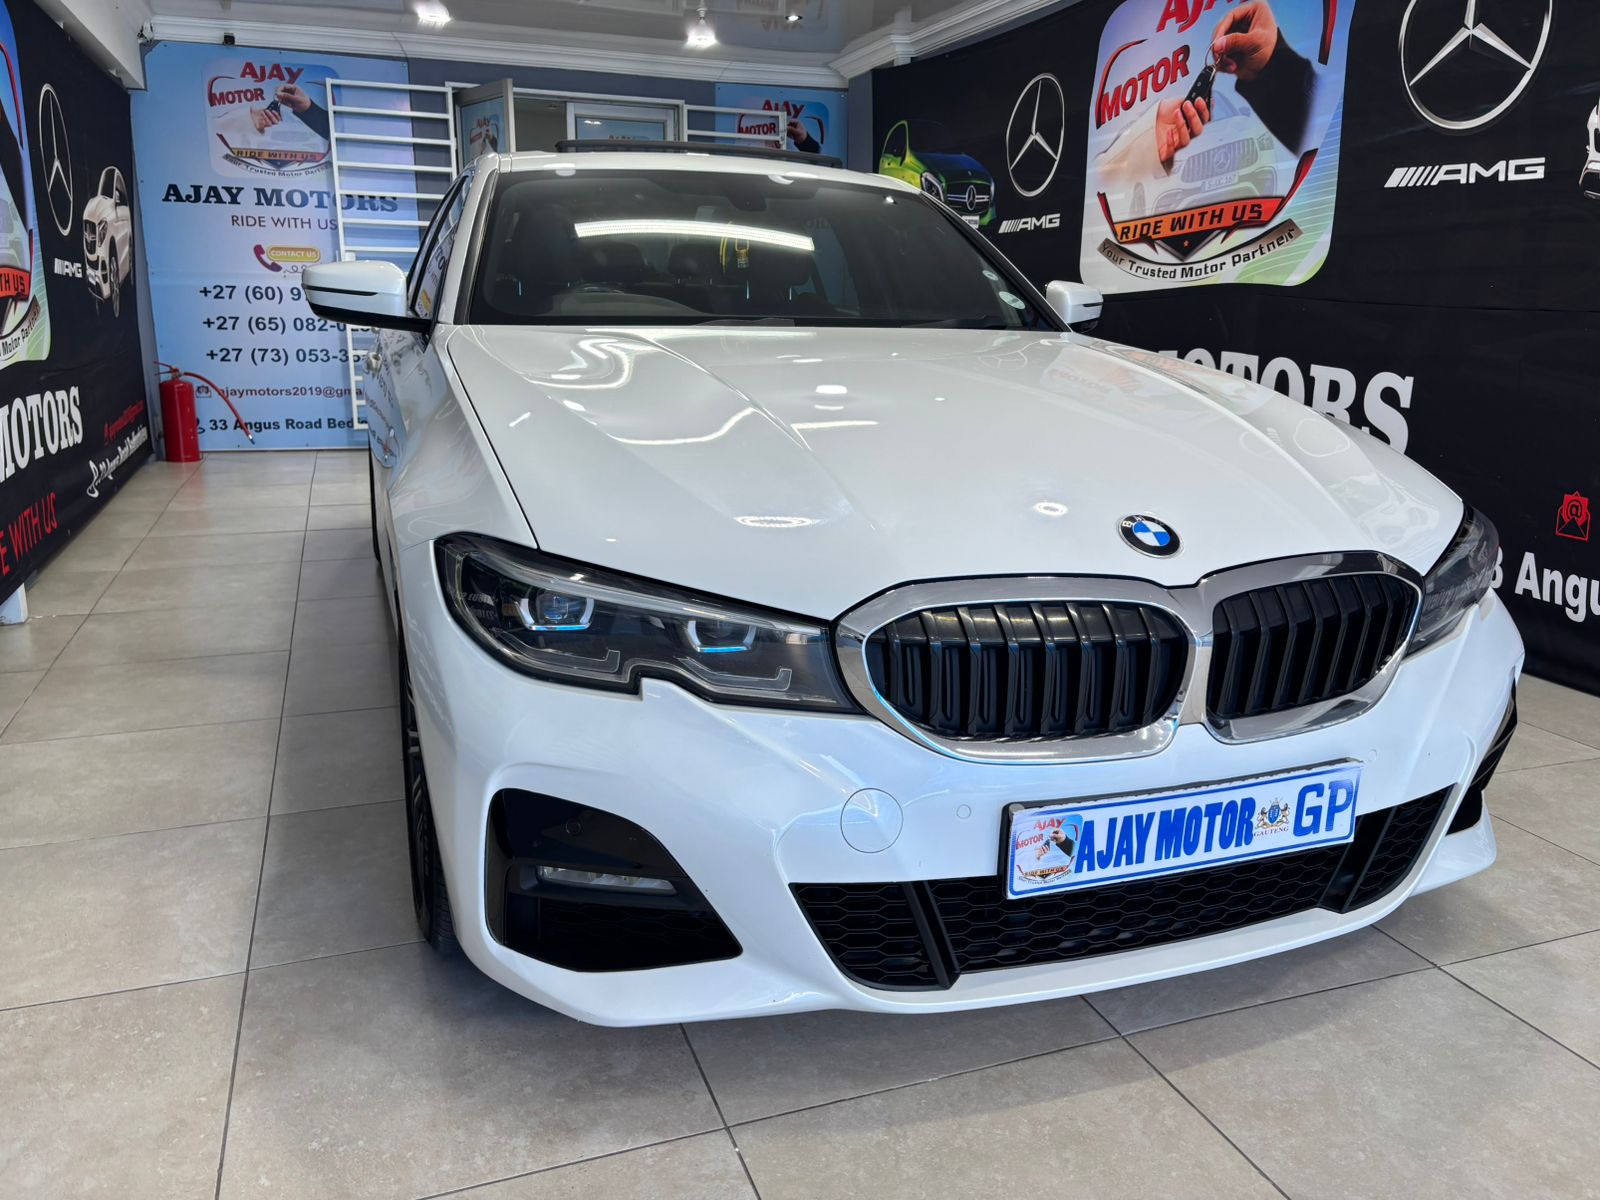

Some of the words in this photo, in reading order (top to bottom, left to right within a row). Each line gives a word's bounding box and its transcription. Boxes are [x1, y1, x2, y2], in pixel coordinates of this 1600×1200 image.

[240, 62, 304, 84] AJAY
[1099, 45, 1190, 126] MOTOR
[211, 88, 265, 106] MOTOR
[268, 151, 297, 159] WITH
[162, 184, 244, 205] AJAY
[254, 188, 398, 212] MOTORS
[231, 215, 266, 228] RIDE
[270, 216, 312, 230] WITH
[318, 219, 338, 231] US
[1119, 220, 1162, 241] RIDE
[1169, 208, 1222, 234] WITH
[1232, 202, 1263, 222] US
[271, 249, 305, 257] CONTACT
[1100, 242, 1125, 266] Your
[1128, 259, 1177, 279] Trusted
[1180, 260, 1227, 279] Motor
[1231, 227, 1297, 267] Partner
[13, 273, 26, 293] US
[199, 284, 237, 300] +27
[245, 285, 284, 304] (60)
[202, 316, 239, 330] +27
[248, 316, 286, 335] (65)
[1, 333, 21, 356] Motor
[206, 347, 243, 362] +27
[251, 347, 289, 367] (73)
[209, 419, 228, 431] 33
[233, 418, 280, 433] Angus
[285, 418, 322, 429] Road
[8, 499, 43, 561] WITH
[42, 491, 59, 535] US
[1033, 817, 1066, 831] AJAY
[1074, 811, 1156, 873] AJAY
[1155, 797, 1256, 861] MOTOR
[1292, 778, 1354, 836] GP
[1254, 826, 1289, 837] GAUTENG
[1016, 833, 1044, 850] MOTOR
